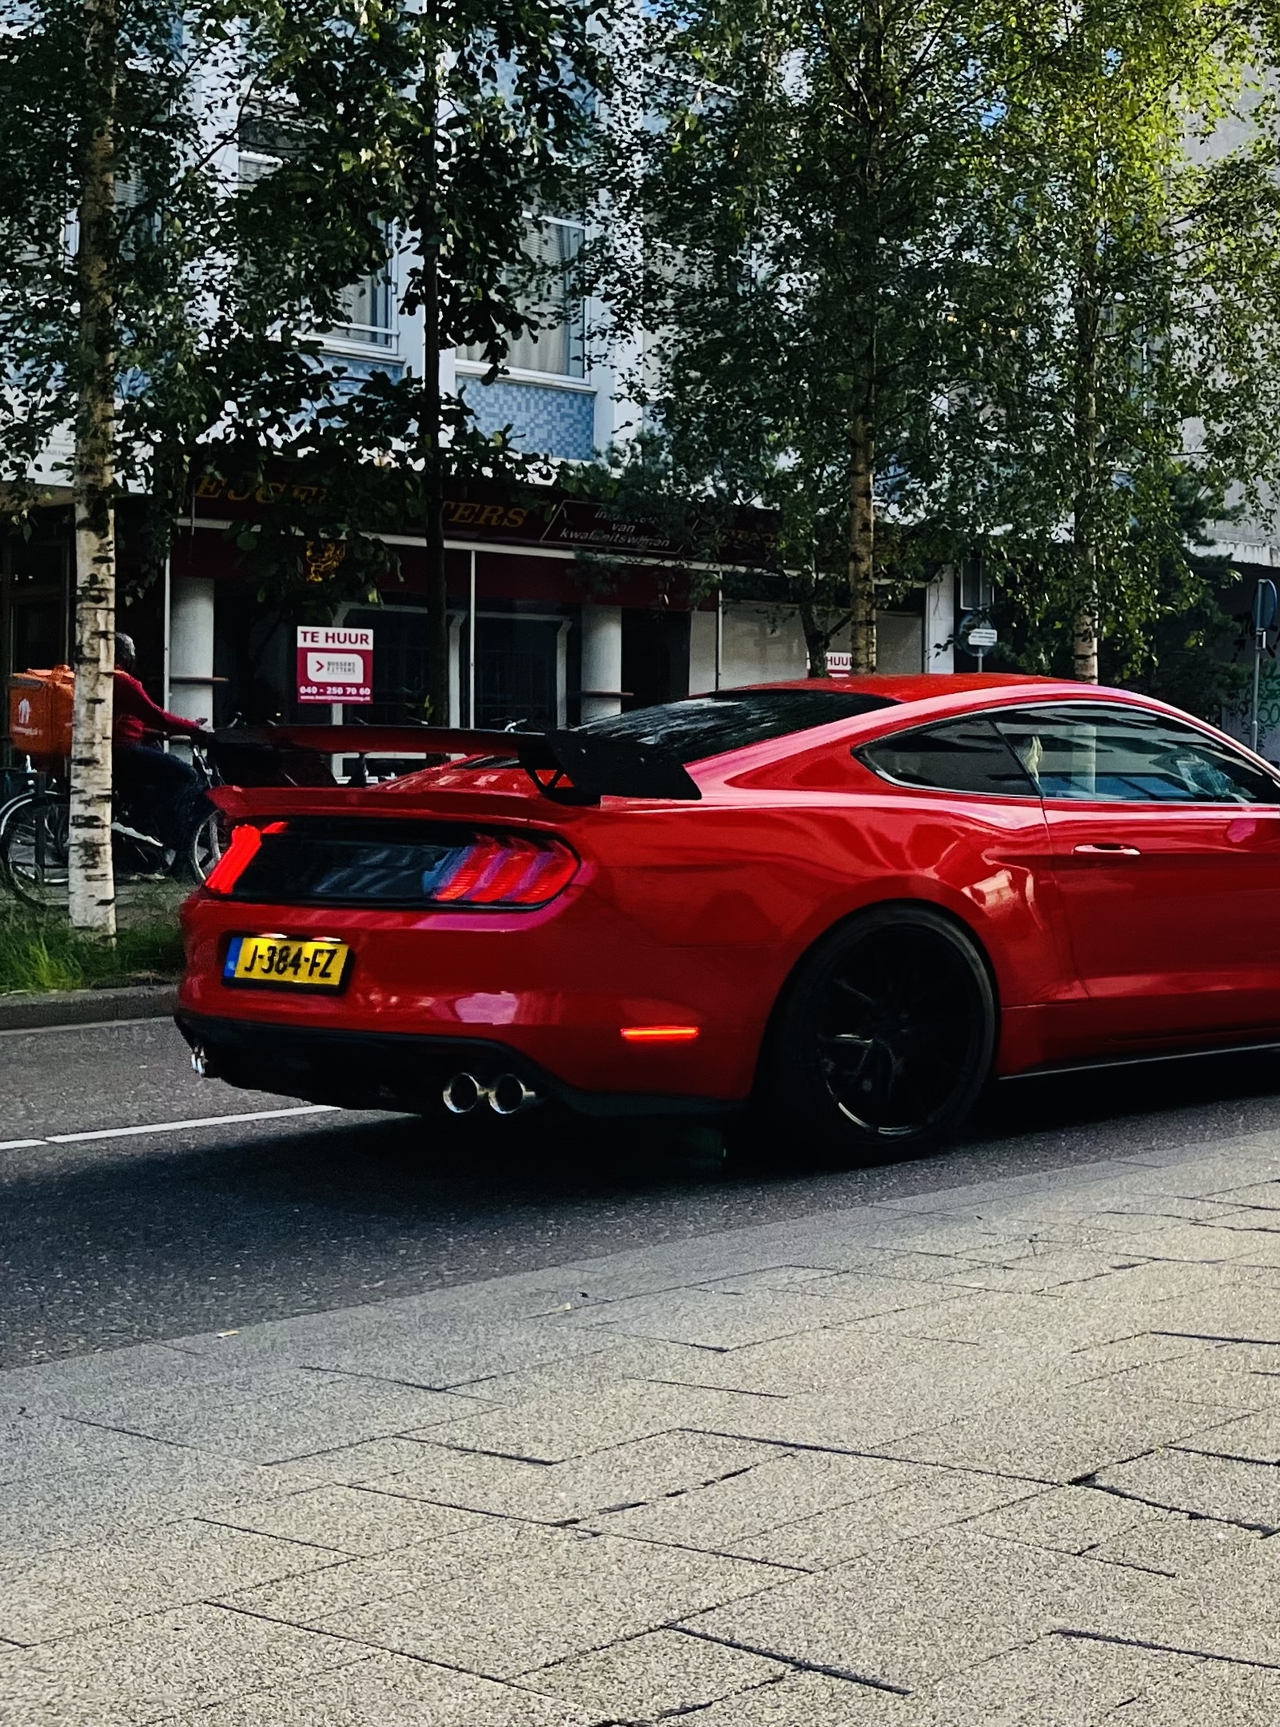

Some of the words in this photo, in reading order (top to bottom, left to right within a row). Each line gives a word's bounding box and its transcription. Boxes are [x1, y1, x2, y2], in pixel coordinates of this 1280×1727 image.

[611, 522, 636, 533] van
[301, 631, 320, 643] TE
[325, 632, 370, 645] HUUR
[300, 686, 317, 694] 040
[326, 686, 344, 695] 250
[346, 687, 358, 695] 70
[359, 687, 371, 696] 60
[244, 945, 338, 978] J-384-FZ
